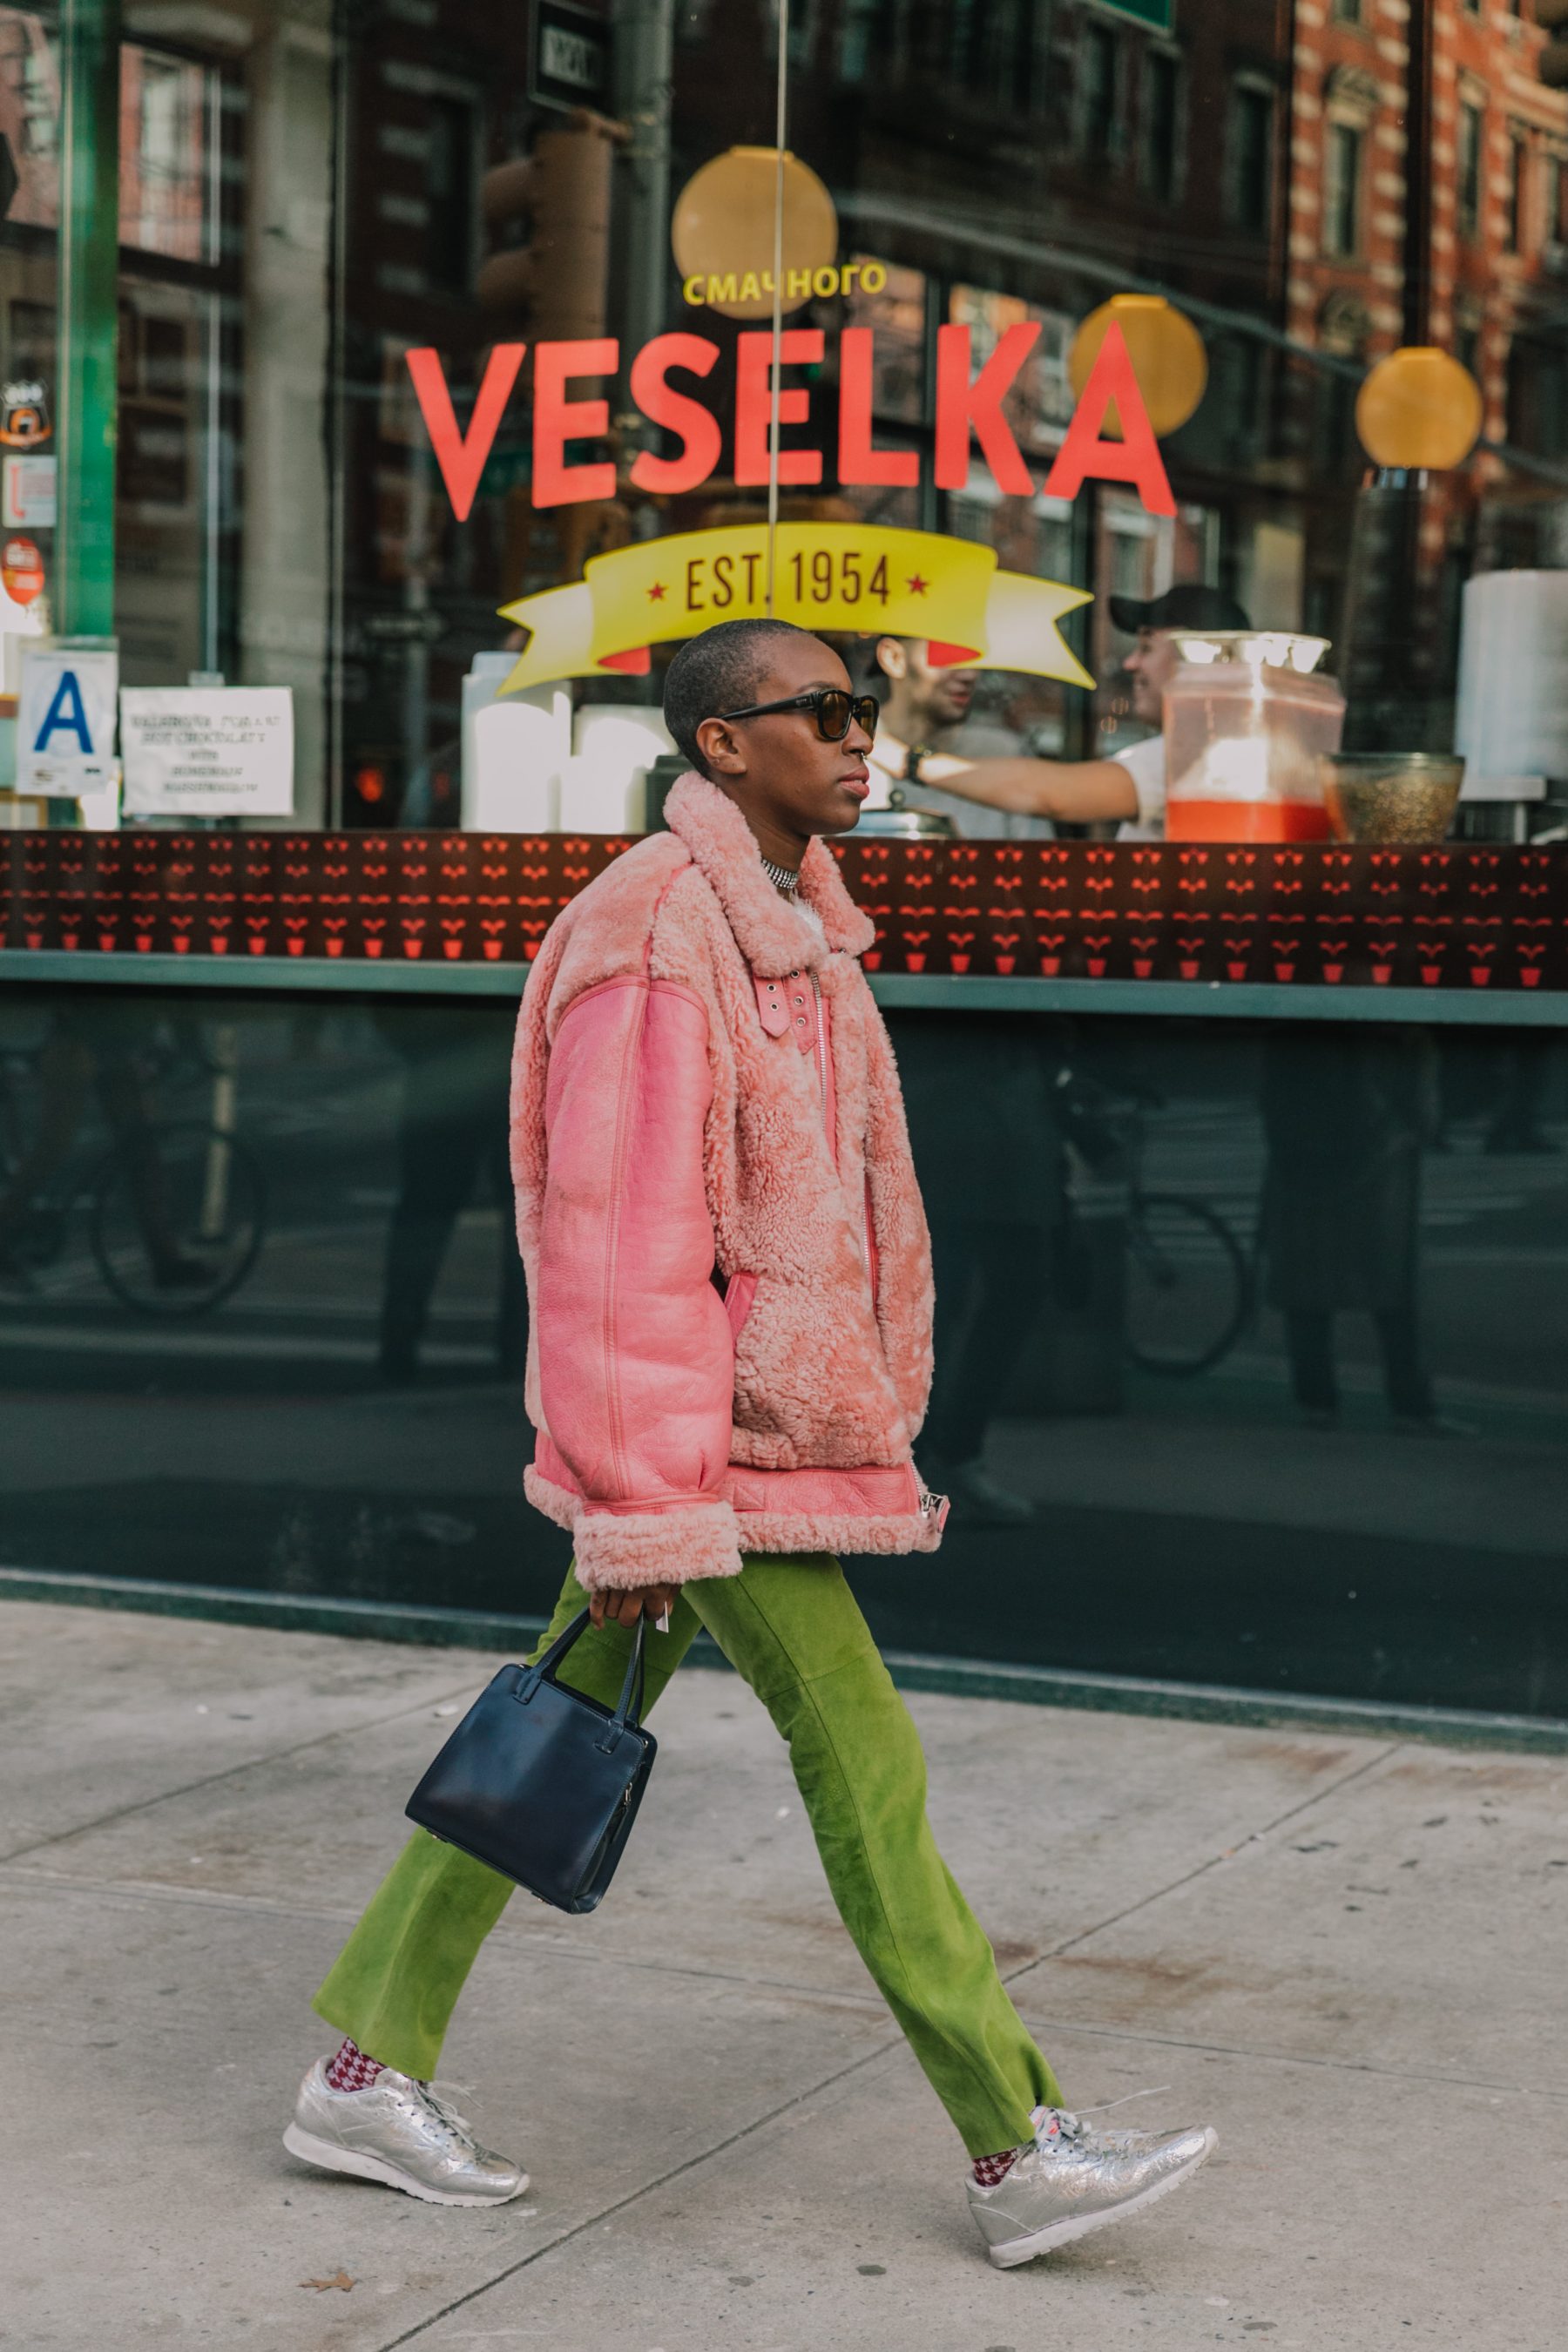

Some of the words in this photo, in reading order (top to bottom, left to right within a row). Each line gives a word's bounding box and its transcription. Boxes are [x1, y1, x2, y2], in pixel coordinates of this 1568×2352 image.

[683, 263, 887, 306] СМАЧНОГО
[406, 321, 1177, 523] VESELKA
[686, 553, 772, 612] EST.
[791, 551, 889, 605] 1954
[34, 670, 95, 754] A
